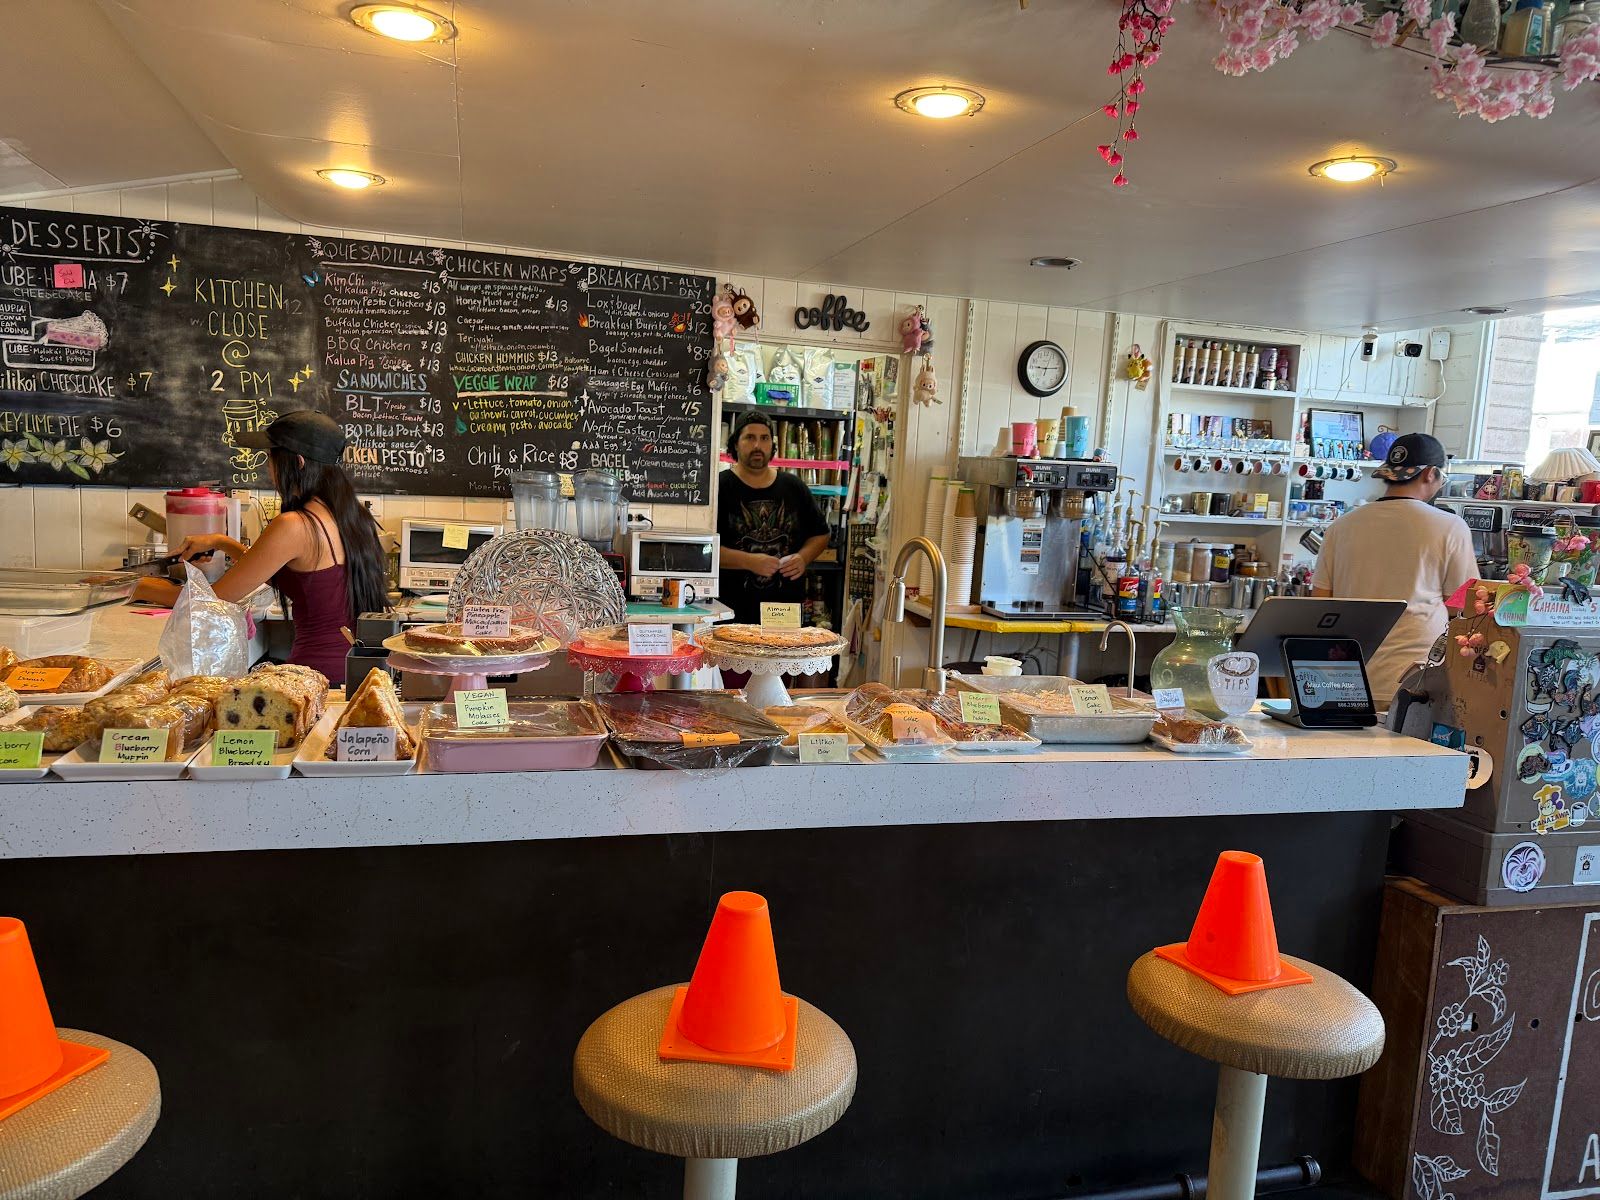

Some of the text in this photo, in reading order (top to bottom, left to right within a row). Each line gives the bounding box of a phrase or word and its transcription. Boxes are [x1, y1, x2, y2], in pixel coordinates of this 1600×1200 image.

[12, 219, 142, 257] DESSERTS
[323, 242, 436, 266] QUESADILLAS
[446, 256, 568, 281] CHICKEN WRAPS
[447, 279, 458, 291] All
[460, 284, 482, 294] wraps
[493, 284, 518, 293] spinach
[680, 277, 700, 288] ALL
[13, 287, 92, 301] CHEESECAKE
[194, 278, 283, 309] KITCHEN
[344, 286, 421, 299] Kalua cheese
[481, 289, 503, 298] served
[680, 288, 701, 299] DAY
[324, 294, 360, 309] Creamy
[362, 297, 387, 307] Pesto
[388, 297, 424, 309] Chicken
[456, 295, 481, 306] Honey
[483, 297, 518, 306] Mustard
[587, 293, 609, 308] Lox
[616, 295, 641, 312] bagel
[457, 316, 485, 325] Caesar
[795, 294, 870, 332] coffee
[208, 311, 268, 340] CLOSE
[324, 316, 361, 328] Buffalo
[363, 318, 401, 330] Chicken
[588, 314, 632, 329] Breakfast
[635, 318, 667, 331] Burrito
[326, 336, 361, 353] BBQ
[365, 337, 412, 352] Chicken
[457, 333, 494, 344] Teriyaki
[222, 340, 250, 367] @
[589, 339, 664, 357] Bagel Sandwich
[325, 352, 356, 366] Kalua
[359, 353, 375, 369] Pig
[455, 352, 492, 364] CHICKEN
[496, 353, 535, 363] HUMMUS
[643, 358, 667, 366] cheddar
[589, 366, 609, 376] Ham
[617, 366, 644, 378] Cheese
[646, 368, 680, 378] Croissant
[40, 371, 115, 398] CHEESECAKE
[210, 370, 272, 396] 2 PM
[337, 369, 428, 391] SANDWICHES
[453, 374, 500, 391] VEGGIE
[504, 375, 537, 391] WRAP
[588, 377, 625, 387] Sausage
[631, 382, 645, 394] Egg
[648, 380, 678, 392] Muffin
[346, 395, 383, 413] BLT
[588, 400, 631, 414] Avocado
[632, 401, 665, 415] Toast
[60, 415, 80, 437] PIE
[365, 422, 395, 437] Pulled
[396, 423, 422, 438] Pork
[583, 420, 681, 440] North Eastern Toast
[391, 441, 416, 449] sauce
[582, 442, 600, 450] Add
[382, 449, 425, 468] PESTO
[468, 445, 501, 465] Chili
[509, 449, 518, 463] &
[523, 443, 555, 464] Rice
[591, 453, 629, 469] BAGEL
[232, 472, 258, 484] CUP
[624, 470, 648, 483] Bagel
[1534, 601, 1569, 613] LAHAINA
[1224, 677, 1250, 690] TIPS
[464, 692, 495, 700] VEGAN
[465, 702, 494, 712] Pumpkin
[112, 732, 150, 742] Cream
[223, 735, 254, 745] Lemon
[340, 732, 390, 748] Jalapeño
[115, 743, 159, 753] Blueberry
[218, 748, 263, 758] Blueberry
[347, 745, 371, 756] Corn
[117, 752, 149, 761] Muffin
[1533, 811, 1570, 828] KANAZAWA
